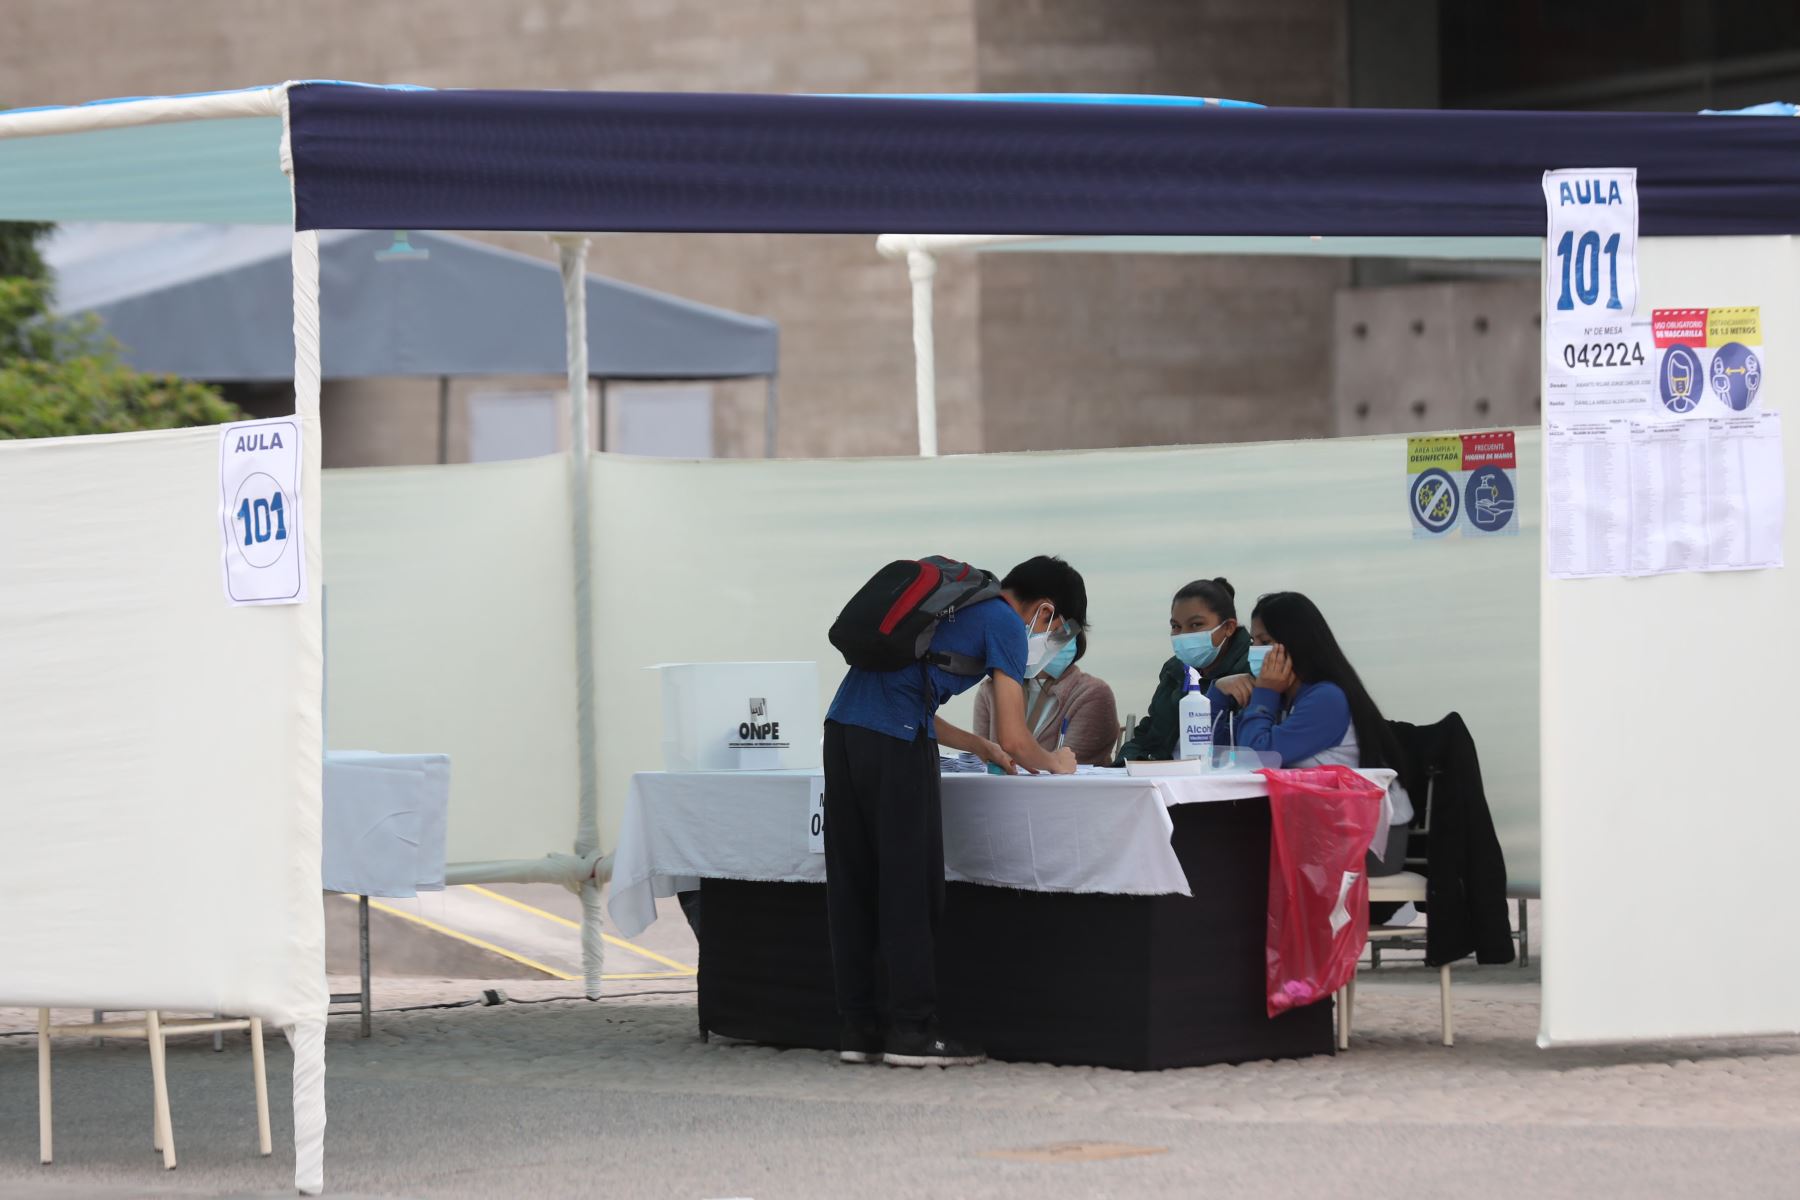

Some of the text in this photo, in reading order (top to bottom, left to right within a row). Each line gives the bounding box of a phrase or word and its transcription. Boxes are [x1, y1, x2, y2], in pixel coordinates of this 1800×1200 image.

[1560, 179, 1622, 206] AULA
[1557, 230, 1623, 311] 101
[1604, 326, 1622, 334] MESA
[1666, 320, 1703, 328] OBLIGATORIO
[1710, 327, 1718, 335] DE
[1730, 326, 1755, 335] METROS
[1664, 329, 1703, 338] MASCARILLA
[1564, 341, 1645, 369] 042224
[235, 432, 284, 453] AULA
[1475, 442, 1504, 451] FRECUENTE
[1410, 453, 1458, 462] DESINFECTADA
[237, 492, 286, 546] 101
[739, 722, 779, 740] ONPE
